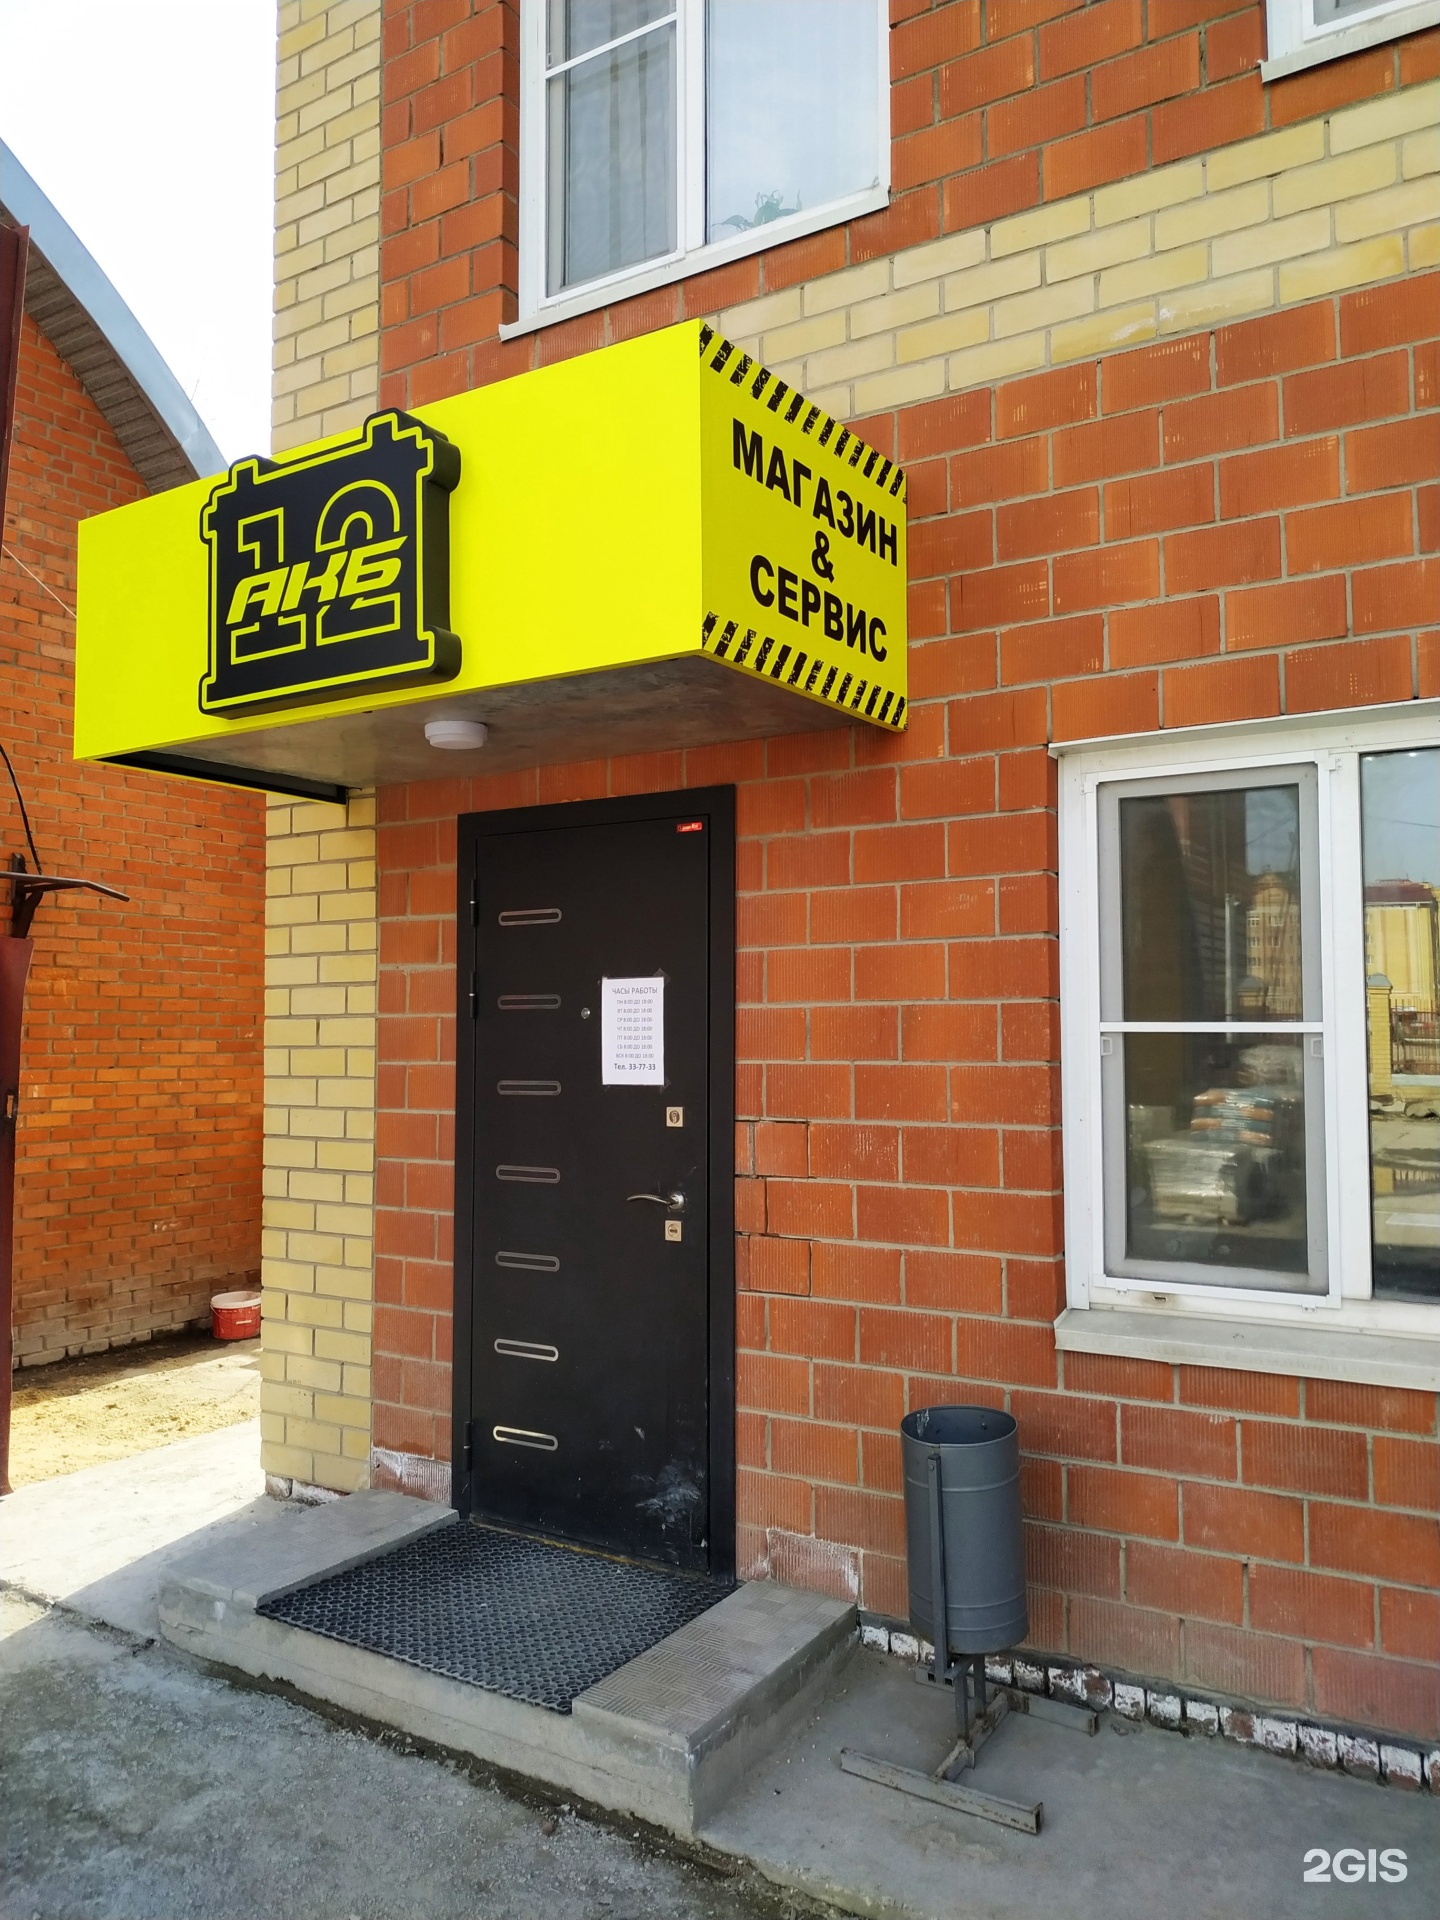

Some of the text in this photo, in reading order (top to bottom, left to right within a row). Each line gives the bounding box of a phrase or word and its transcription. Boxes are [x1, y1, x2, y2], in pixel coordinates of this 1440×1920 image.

[732, 417, 898, 567] МАГАЗИН
[226, 535, 408, 625] АКБ
[811, 530, 835, 583] &
[750, 554, 888, 662] СЕРВИС
[612, 986, 658, 995] ЧАСЫ РАБОТЫ
